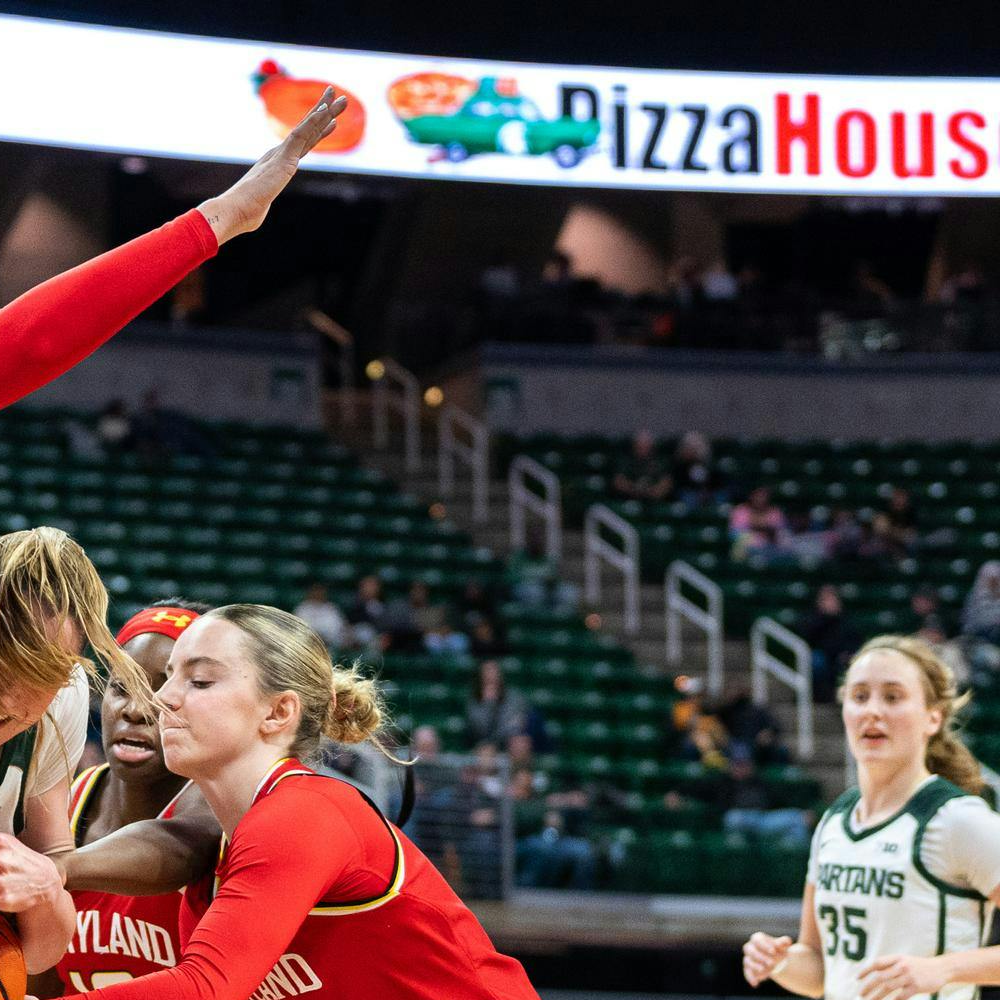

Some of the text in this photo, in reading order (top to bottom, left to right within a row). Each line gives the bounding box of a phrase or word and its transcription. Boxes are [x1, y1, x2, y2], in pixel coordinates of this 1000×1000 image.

[817, 863, 905, 899] ARTANS
[67, 910, 177, 967] YLAND
[819, 904, 867, 962] 35
